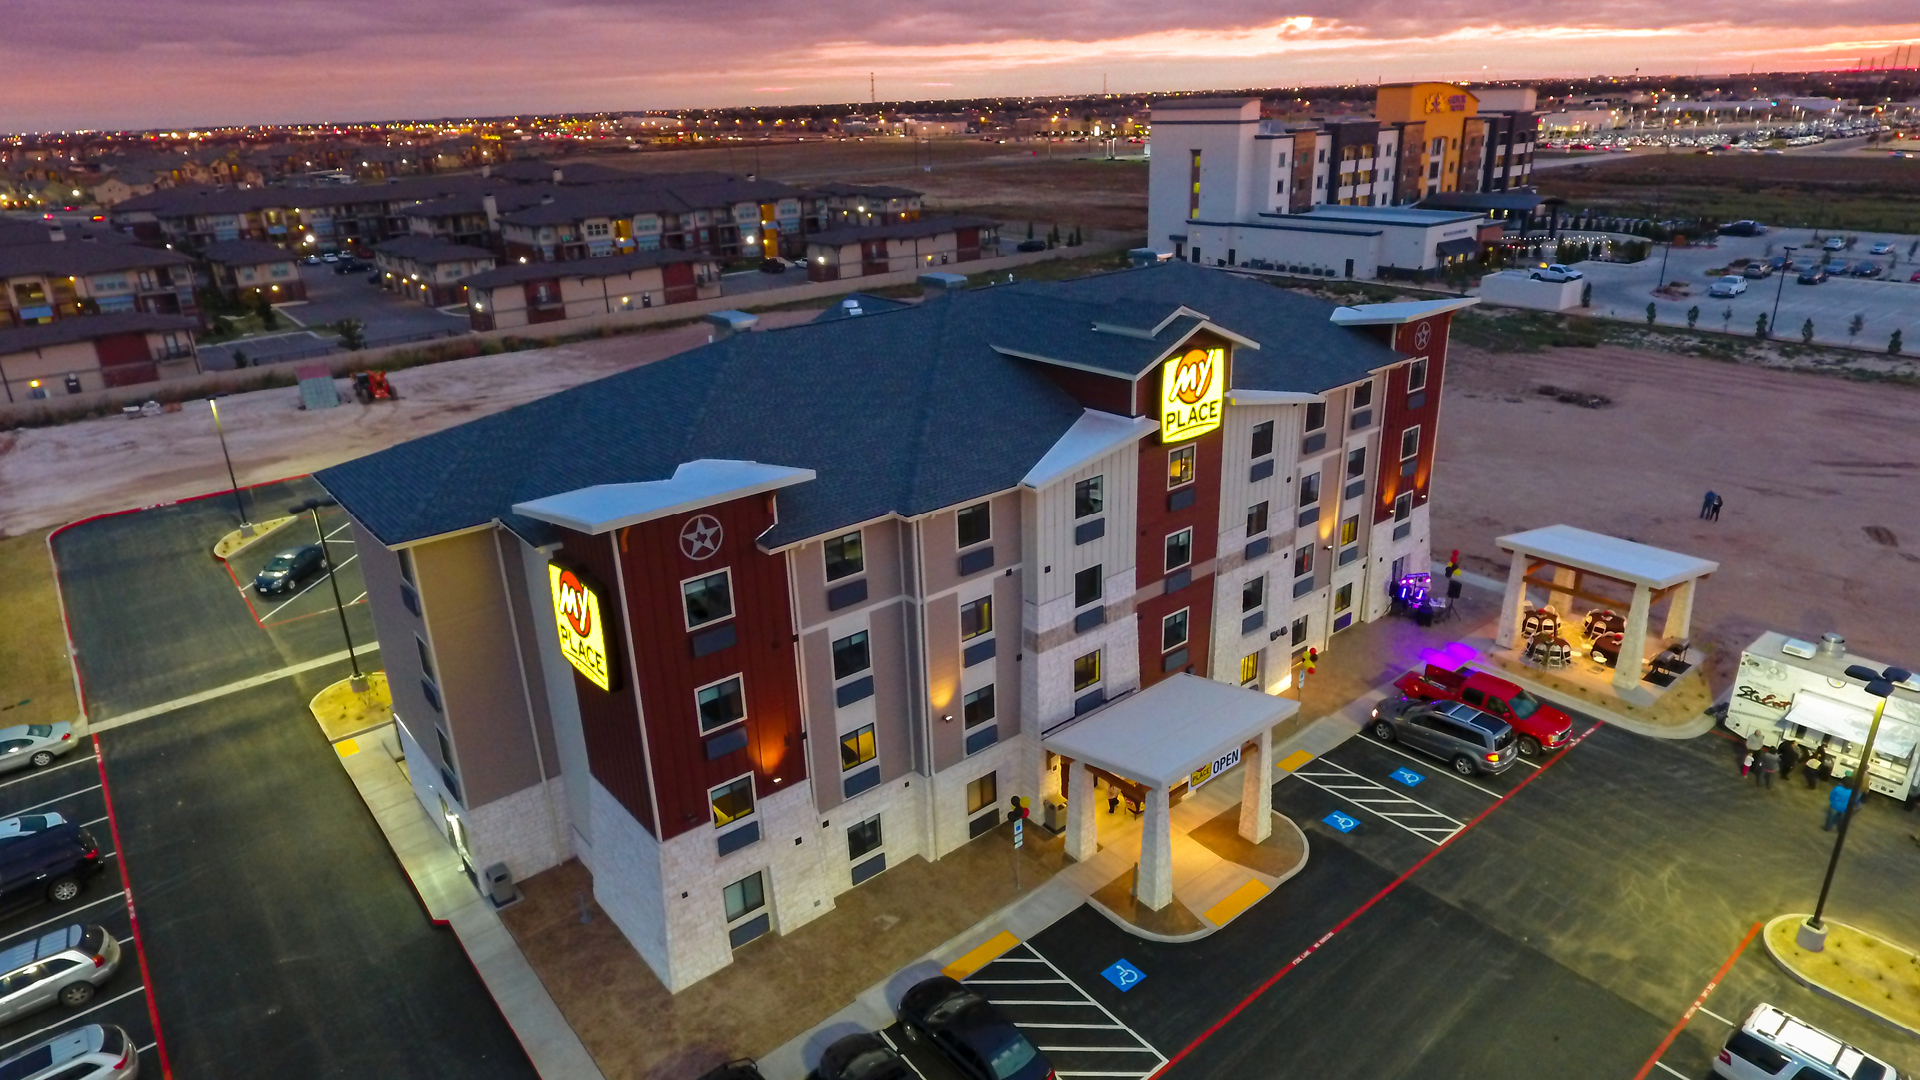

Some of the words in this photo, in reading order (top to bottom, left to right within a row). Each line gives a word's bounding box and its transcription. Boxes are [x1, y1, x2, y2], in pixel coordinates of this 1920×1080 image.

[1166, 400, 1219, 431] PLACE
[560, 624, 605, 676] PLACE
[1192, 767, 1210, 783] PLACE
[1212, 748, 1239, 774] OPEN
